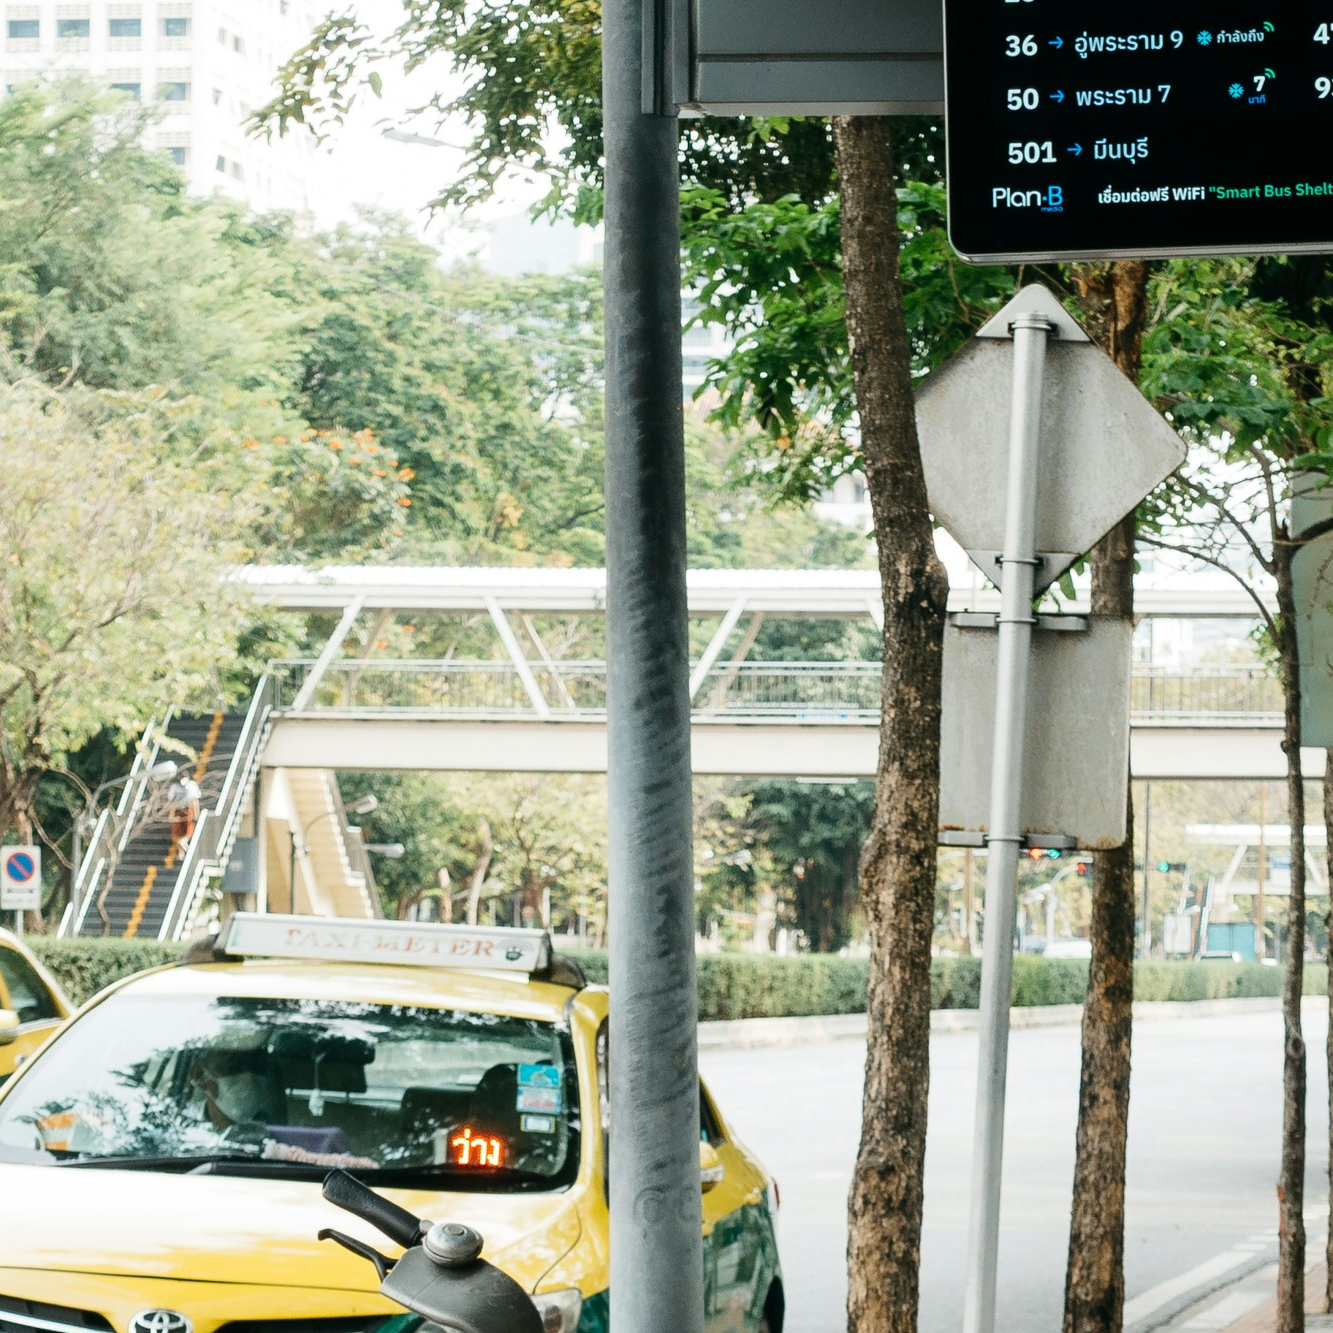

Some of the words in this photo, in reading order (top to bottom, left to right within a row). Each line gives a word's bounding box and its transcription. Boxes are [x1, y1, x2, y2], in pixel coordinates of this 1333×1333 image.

[1005, 35, 1038, 57] 36
[1075, 31, 1163, 59] อู่พระราม
[1170, 30, 1183, 48] 9
[1217, 29, 1265, 43] กำลังถึง
[1253, 76, 1264, 92] 7
[1007, 88, 1039, 110] 50
[1076, 88, 1151, 106] พระราม
[1158, 85, 1171, 103] 7
[1008, 141, 1057, 164] 501
[1094, 136, 1148, 164] มีนบุรี
[1098, 185, 1169, 204] เชื่อมต่อฟรี
[1172, 186, 1205, 201] WiFi
[1209, 186, 1260, 199] "Smart
[1265, 185, 1291, 197] Bus
[452, 1127, 501, 1166] ว่าง
